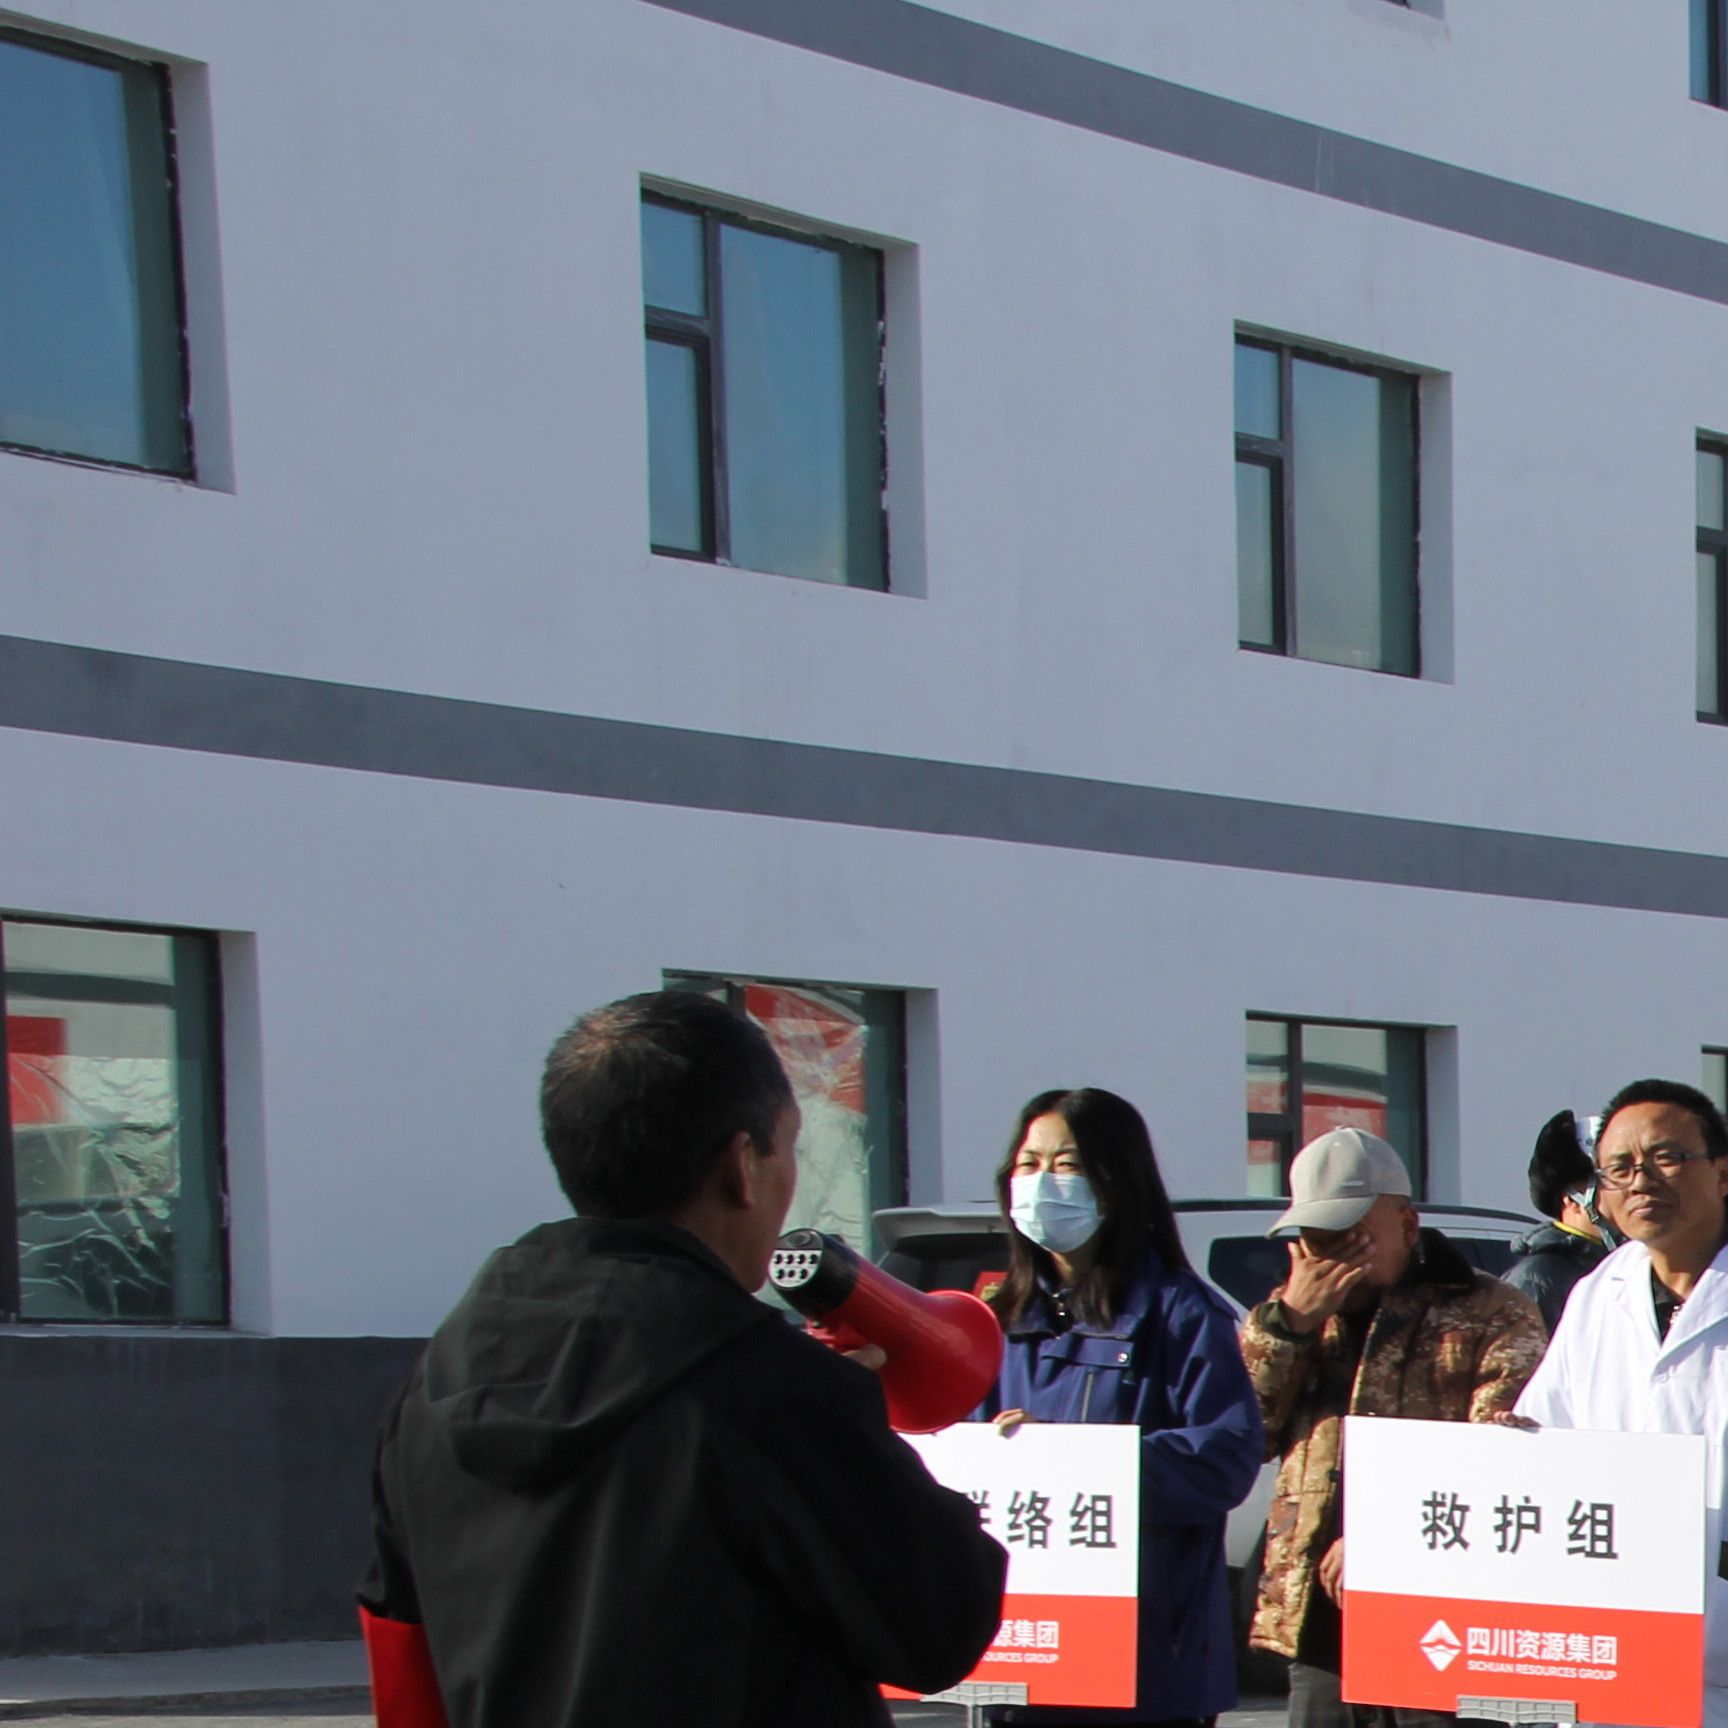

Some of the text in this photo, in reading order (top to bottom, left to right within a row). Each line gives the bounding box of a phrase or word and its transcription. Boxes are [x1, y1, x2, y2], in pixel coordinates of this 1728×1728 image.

[1420, 1490, 1619, 1560] 救护组
[1023, 1652, 1059, 1664] GROUP
[1466, 1626, 1618, 1667] 四川资源集团
[1466, 1659, 1617, 1681] SICHUAN RESOURCES GROUP
